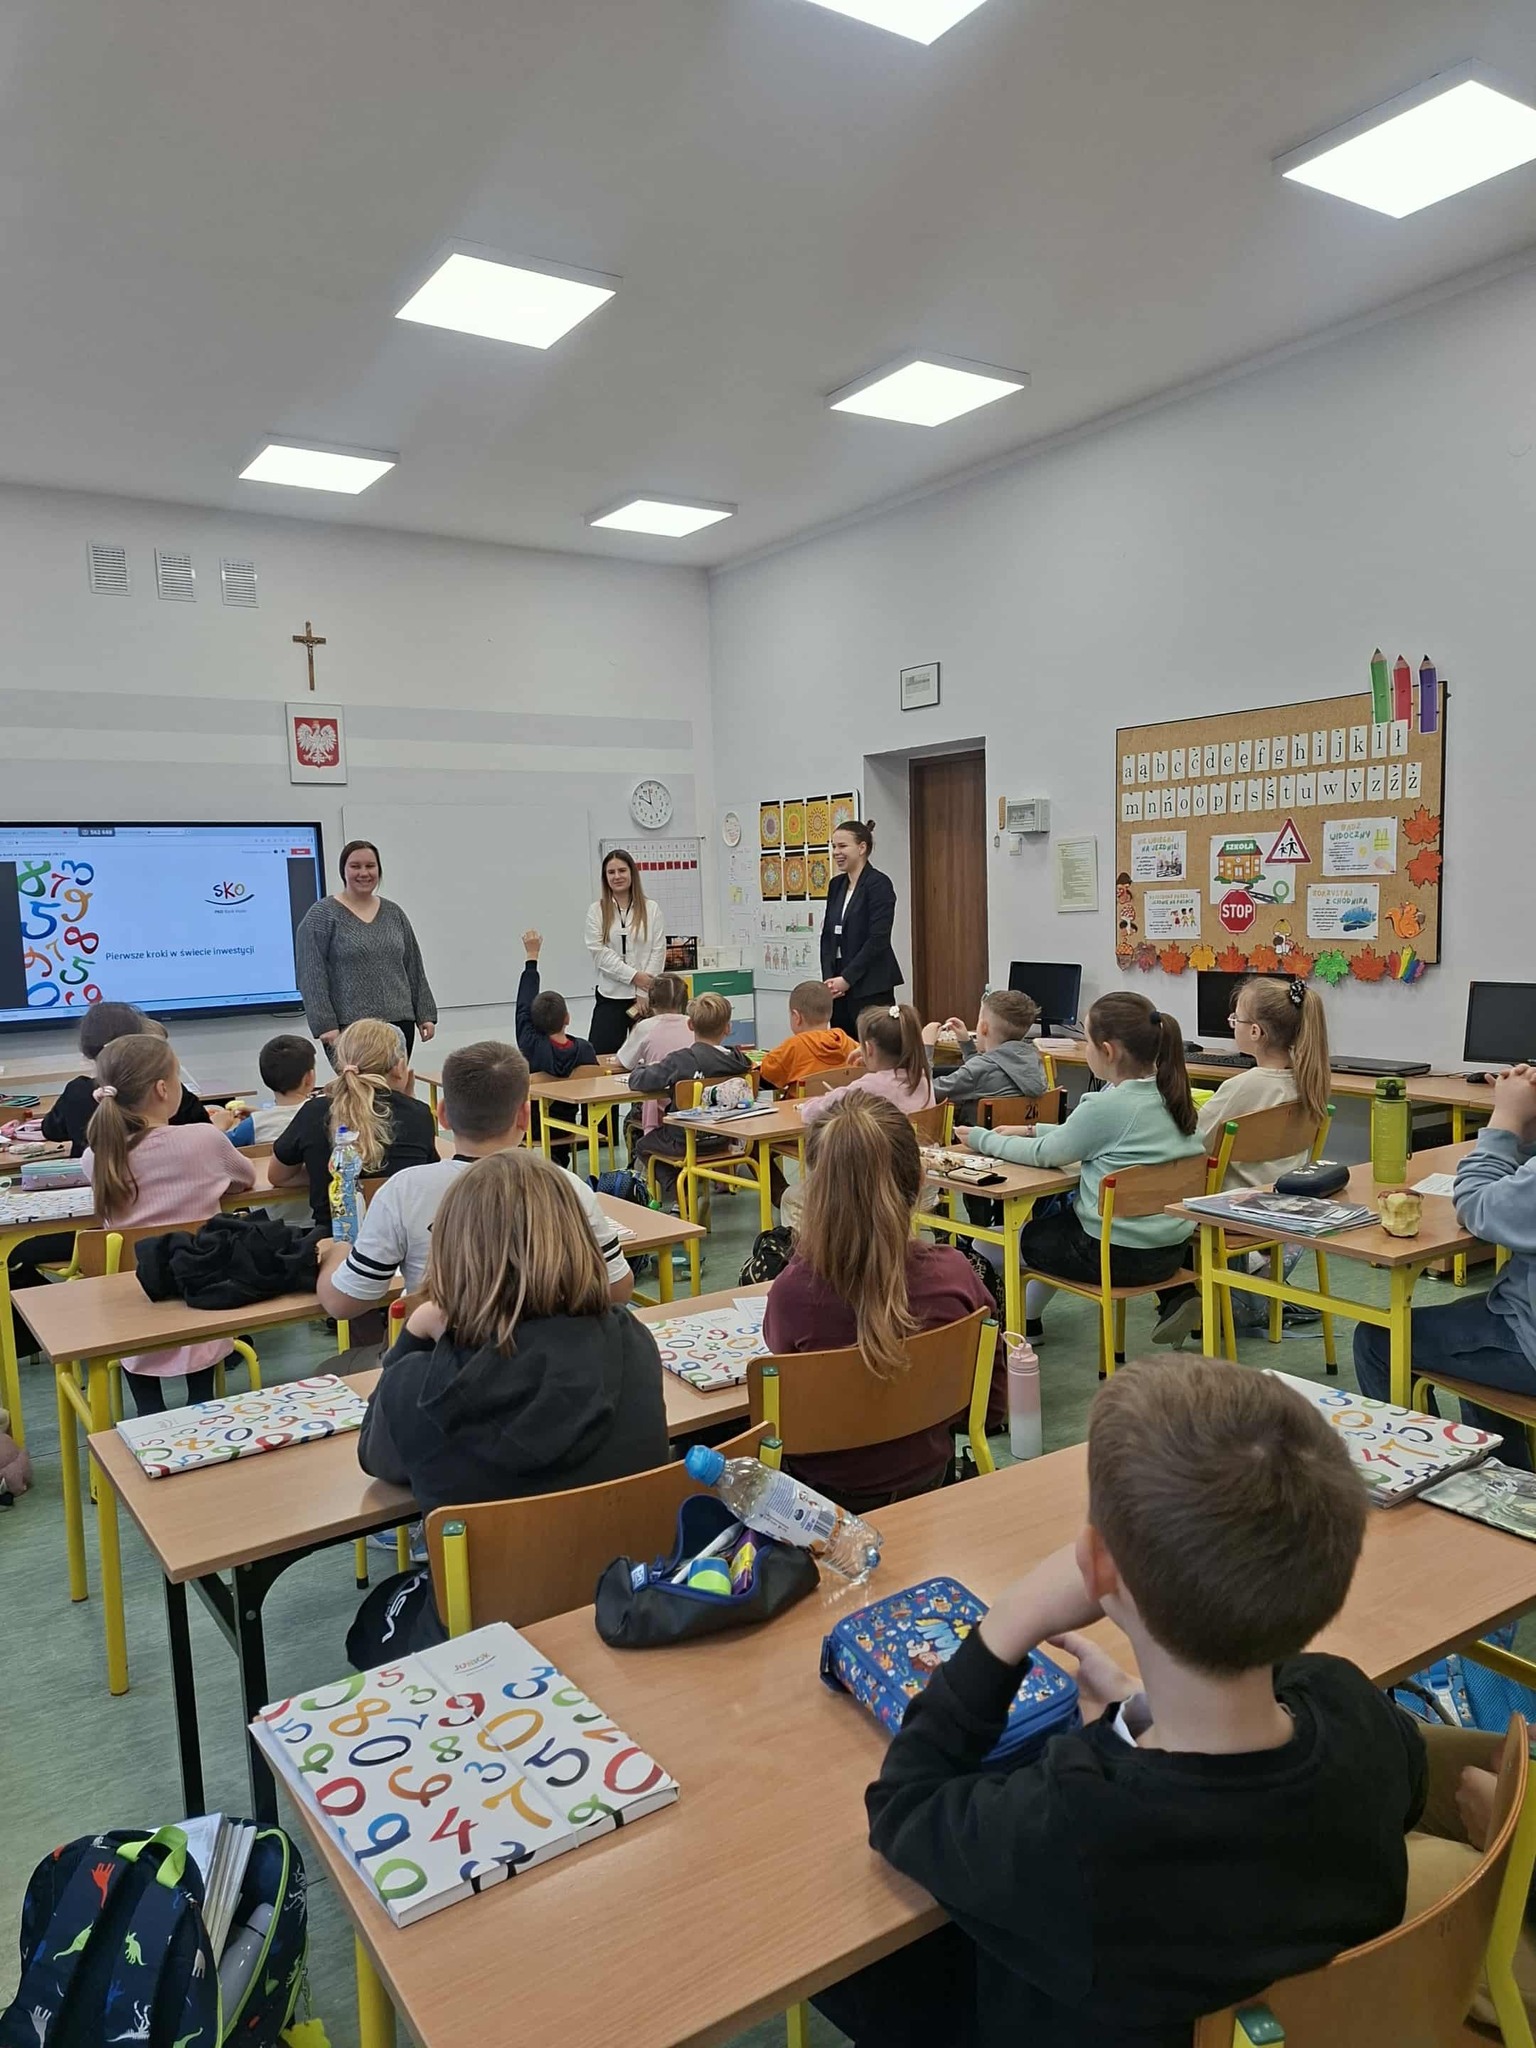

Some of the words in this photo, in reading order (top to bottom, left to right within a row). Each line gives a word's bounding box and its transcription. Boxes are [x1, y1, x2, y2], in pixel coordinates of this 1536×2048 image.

[1124, 767, 1132, 778] a
[1139, 764, 1148, 778] ą
[1156, 758, 1165, 773] b
[1174, 761, 1181, 773] c
[1191, 752, 1199, 769] ć
[1205, 752, 1215, 768] d
[1223, 755, 1232, 767] e
[1240, 753, 1248, 768] ę
[1258, 747, 1266, 764] f
[1274, 748, 1284, 765] g
[1295, 743, 1305, 759] h
[1317, 739, 1323, 757] i
[1335, 736, 1342, 757] j
[1354, 735, 1364, 753] k
[1126, 804, 1139, 815] m
[1148, 802, 1157, 813] n
[1164, 796, 1173, 812] ń
[1180, 798, 1188, 810] o
[1214, 796, 1223, 811] p
[1234, 794, 1241, 805] r
[1251, 791, 1259, 803] s
[1266, 784, 1274, 801] ś
[1284, 787, 1290, 800] t
[1301, 787, 1311, 799] u
[1323, 783, 1338, 796] w
[1350, 781, 1362, 799] y
[1372, 780, 1381, 792] z
[1390, 772, 1399, 791] ź
[1408, 771, 1417, 789] ż
[1222, 903, 1253, 919] STOP
[105, 952, 144, 961] Pierwsze
[146, 949, 169, 959] kroki
[169, 950, 177, 958] w
[180, 947, 212, 957] świecie
[213, 945, 255, 956] inwestycji
